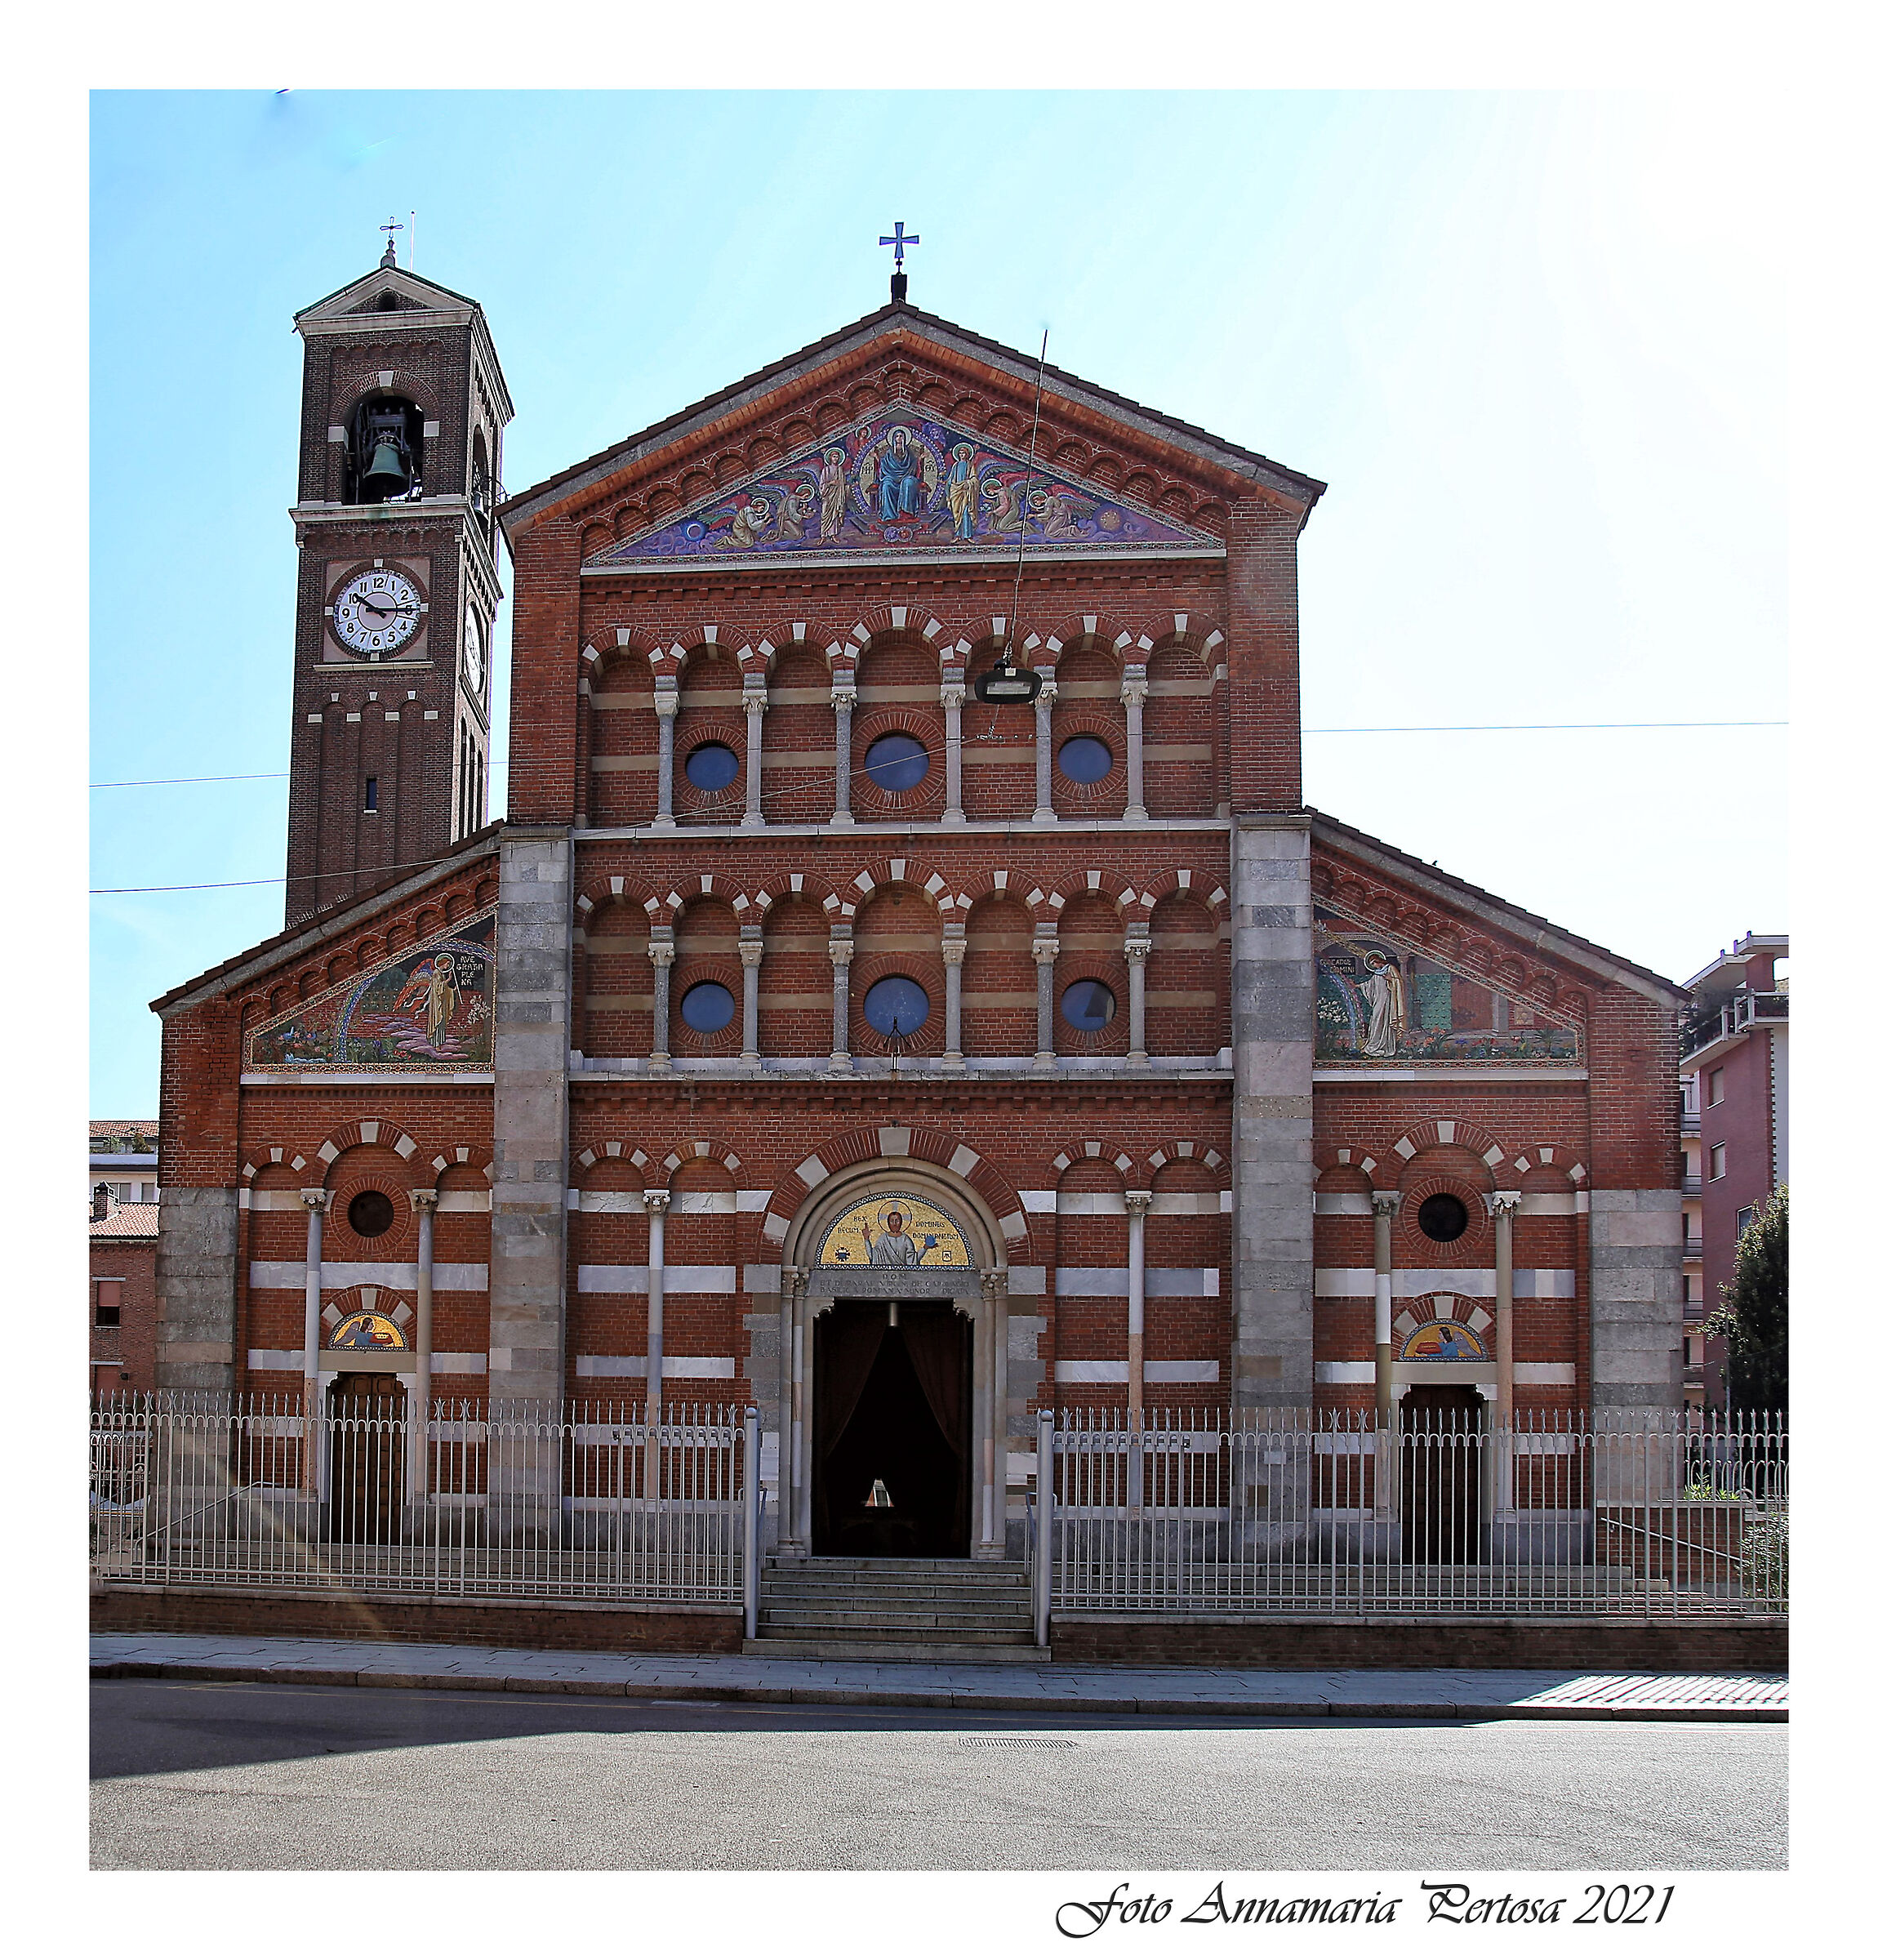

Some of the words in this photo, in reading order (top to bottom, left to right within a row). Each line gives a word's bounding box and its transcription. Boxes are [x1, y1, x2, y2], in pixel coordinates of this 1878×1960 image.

[359, 582, 367, 593] 11
[373, 577, 384, 588] 12
[391, 581, 395, 591] 1
[349, 593, 358, 604] 10
[401, 590, 409, 600] 2
[342, 608, 350, 618] 9
[346, 622, 354, 633] 8
[399, 621, 407, 631] 4
[359, 632, 367, 643] 7
[372, 635, 380, 646] 6
[388, 631, 396, 643] 5
